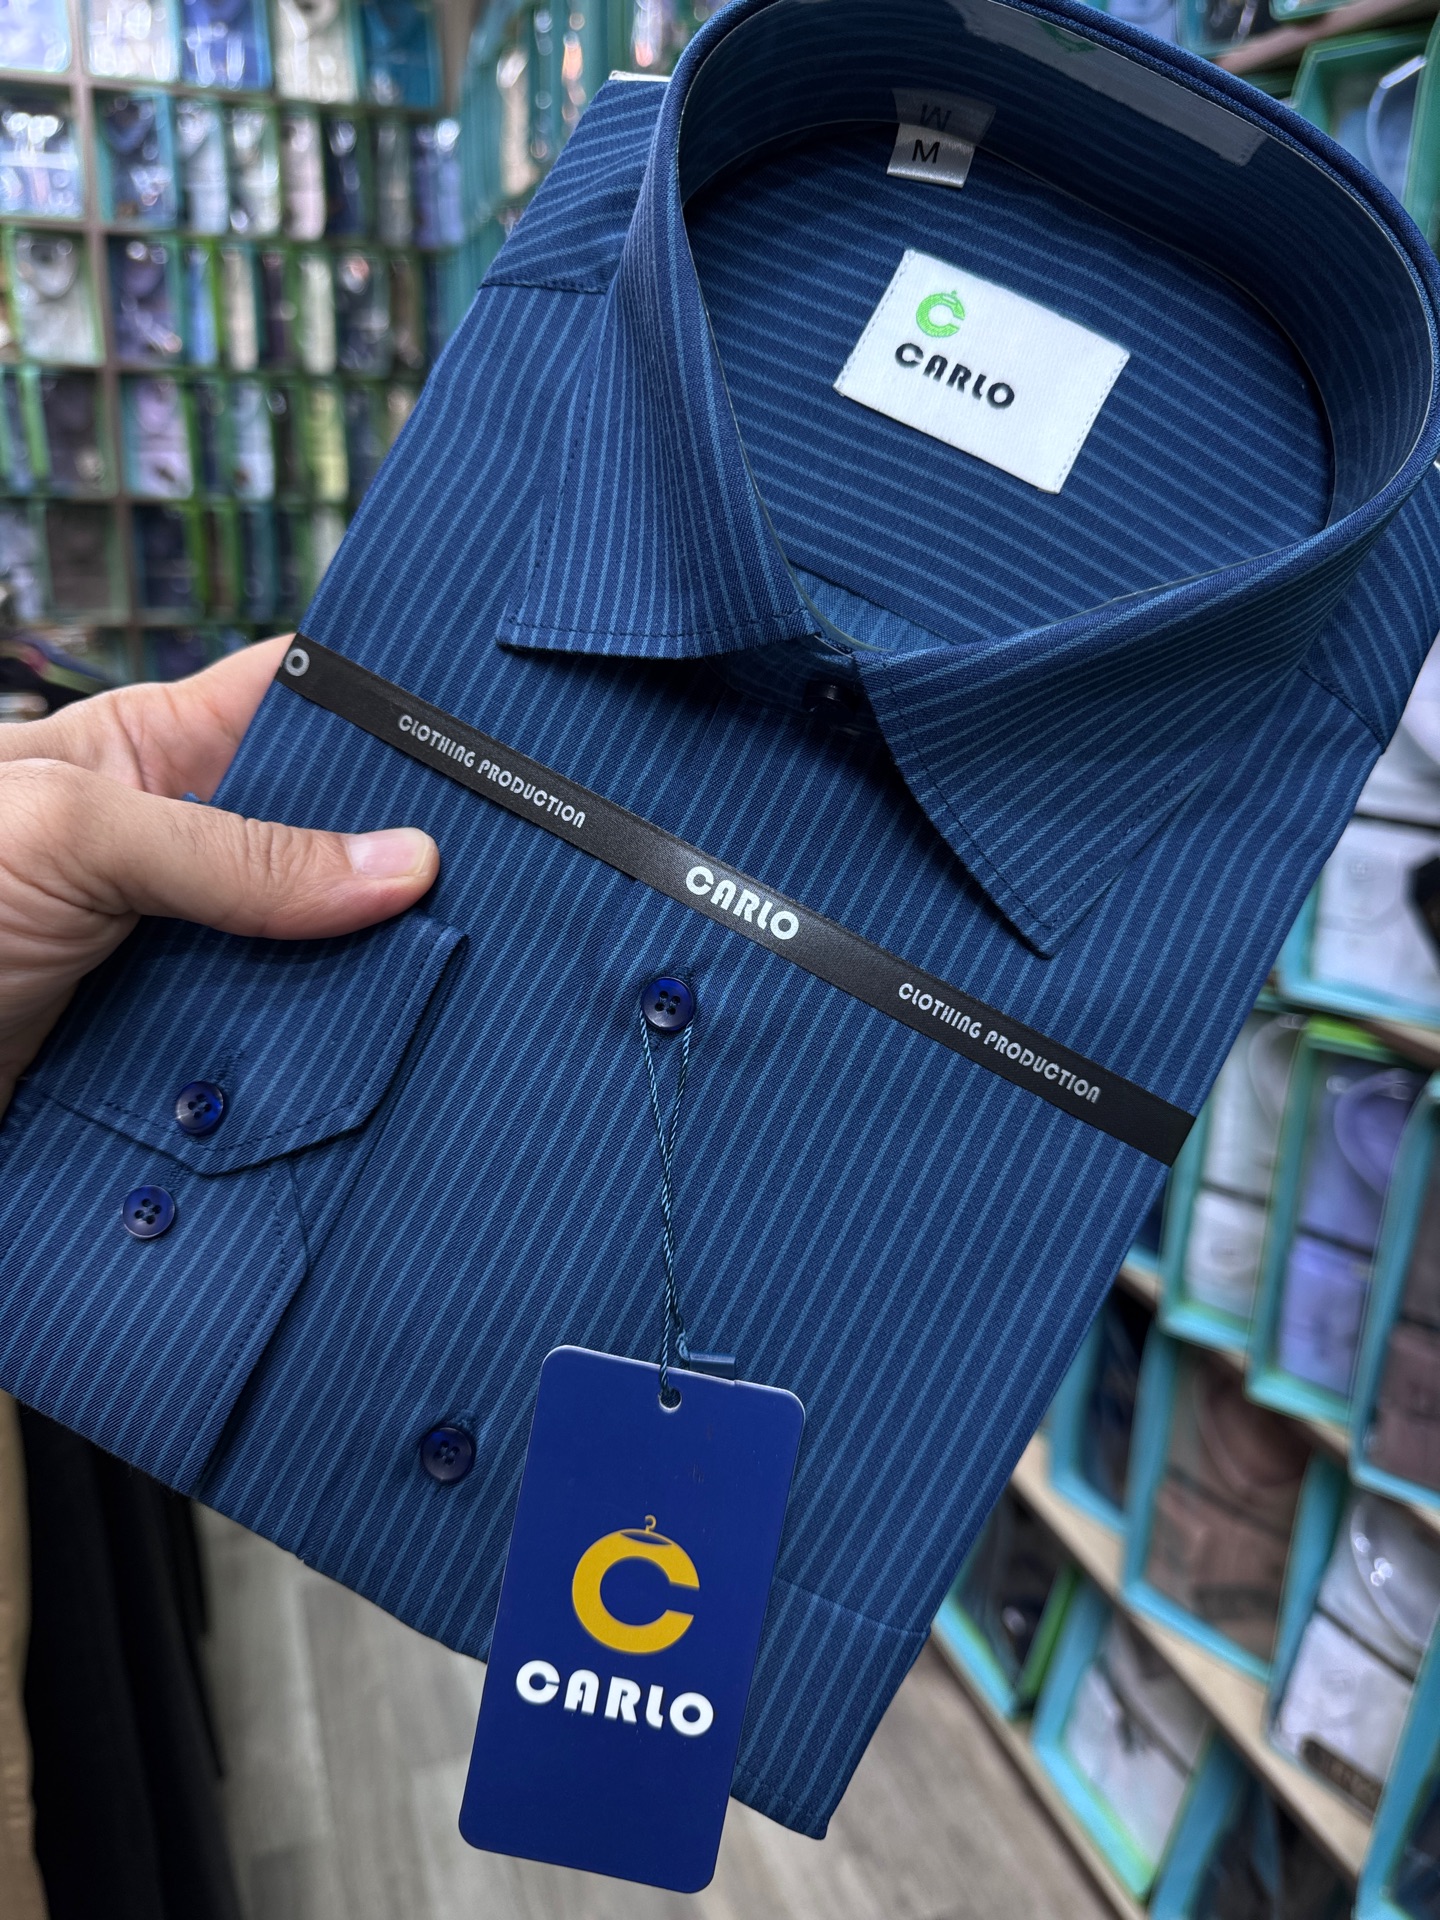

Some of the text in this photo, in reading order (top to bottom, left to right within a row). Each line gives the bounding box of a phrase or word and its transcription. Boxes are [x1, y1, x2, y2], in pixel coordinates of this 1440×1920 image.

[911, 138, 941, 164] M
[894, 342, 1016, 411] CARLO
[398, 714, 587, 829] CLOTHING PRODUCTION
[685, 865, 800, 940] CARLO
[898, 982, 1101, 1104] CLOTHING PRODUCTION
[515, 1659, 715, 1737] CARLO
